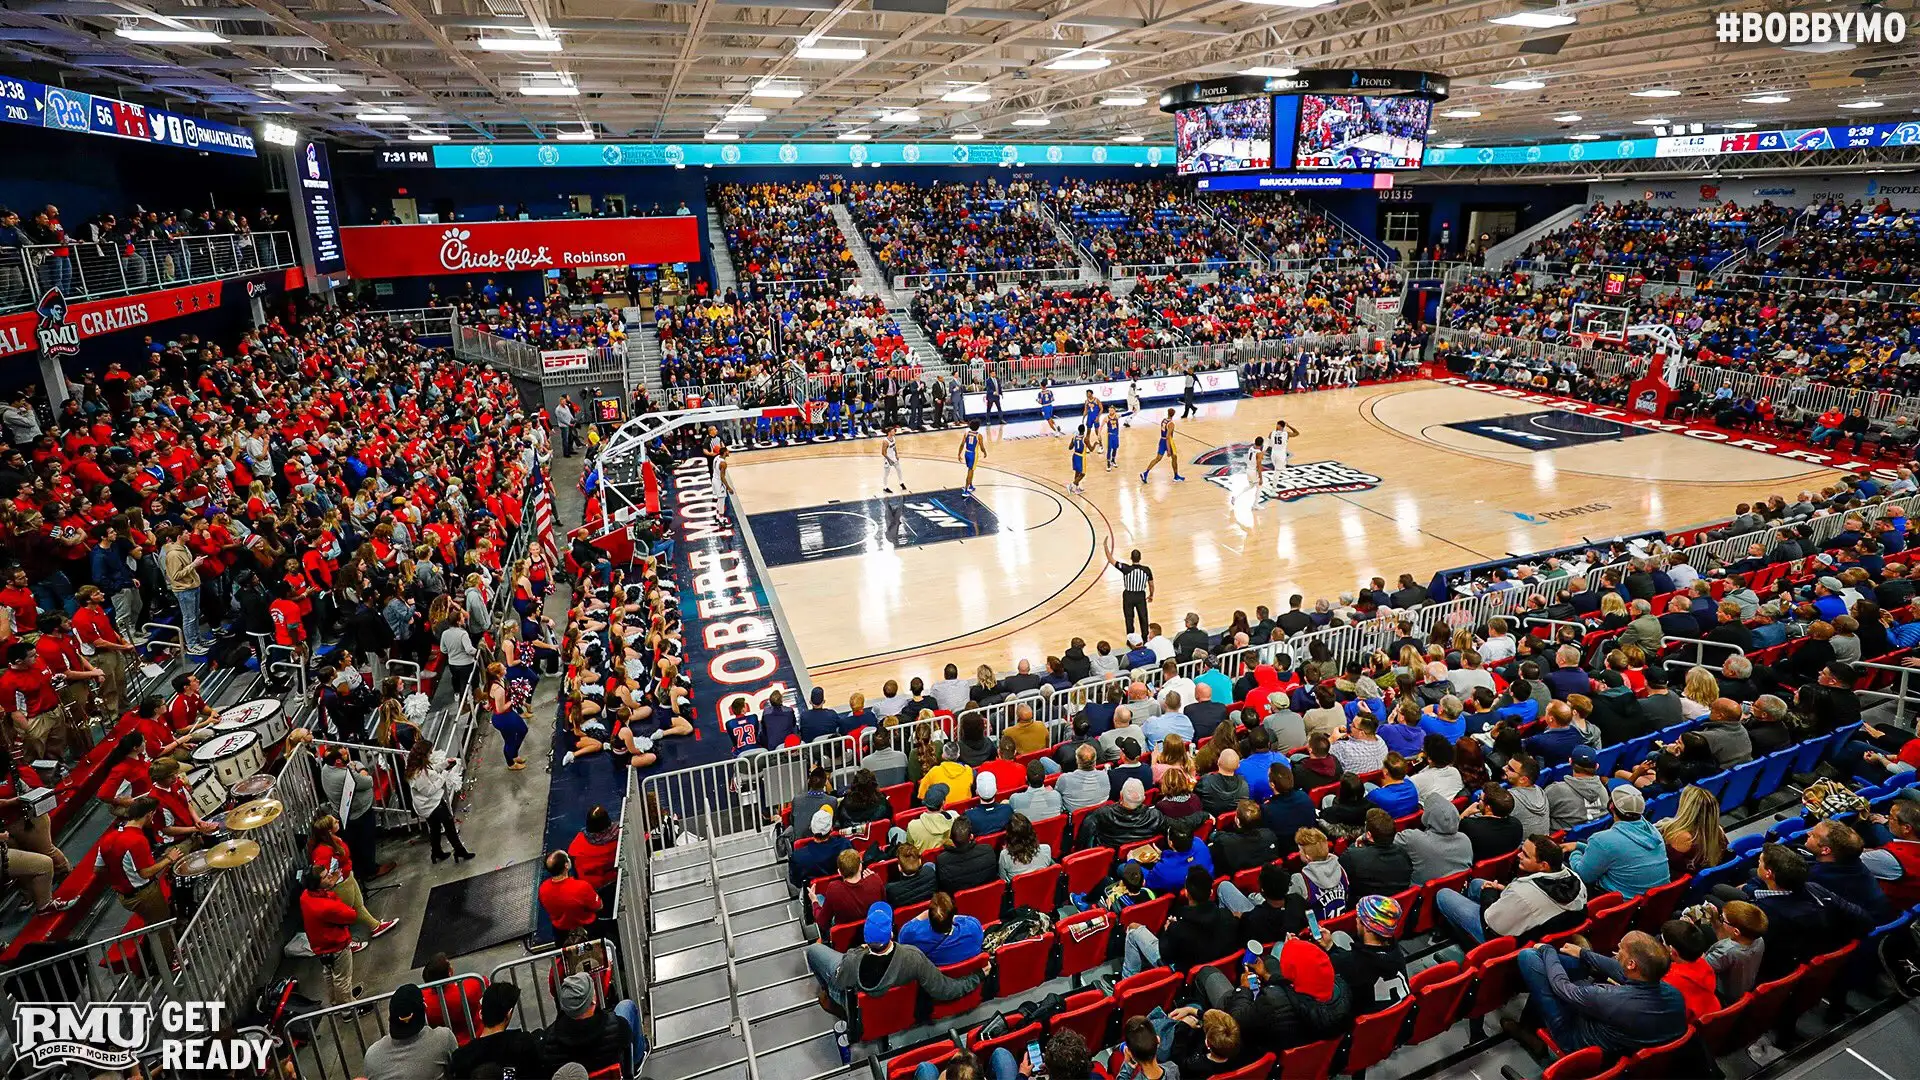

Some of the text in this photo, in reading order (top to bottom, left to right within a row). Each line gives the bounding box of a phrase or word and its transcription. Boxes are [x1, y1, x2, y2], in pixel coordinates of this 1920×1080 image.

[1361, 78, 1391, 86] PEOPLES
[1201, 87, 1227, 96] PEOPLES
[6, 105, 28, 121] 2ND
[48, 90, 88, 130] Pitt
[96, 105, 113, 126] 56
[130, 106, 144, 118] TOL
[124, 119, 144, 136] 1 3
[1848, 127, 1874, 137] 9:38
[198, 127, 254, 150] RMUATHLETICS
[1760, 136, 1777, 147] 43
[1849, 139, 1869, 147] 2ND
[1726, 142, 1750, 151] 2 7
[383, 151, 428, 163] 7:31 PM
[1655, 191, 1677, 199] PNC
[1879, 185, 1920, 194] PEOPLE
[440, 234, 626, 271] Chick-fil-A Robinson
[1606, 281, 1621, 293] 30
[1377, 300, 1399, 310] ESPN
[81, 303, 149, 335] CRAZIES
[39, 324, 78, 353] RMU
[544, 354, 587, 368] ESPN
[602, 408, 616, 419] 30
[1434, 376, 1903, 481] ROBERT MORRIS
[1076, 440, 1081, 449] 1
[1274, 436, 1283, 445] 15
[1280, 484, 1366, 499] COLONIALS
[1538, 503, 1612, 521] PEOPLES
[673, 456, 789, 733] ROBERT MORRIS
[733, 724, 757, 748] 23
